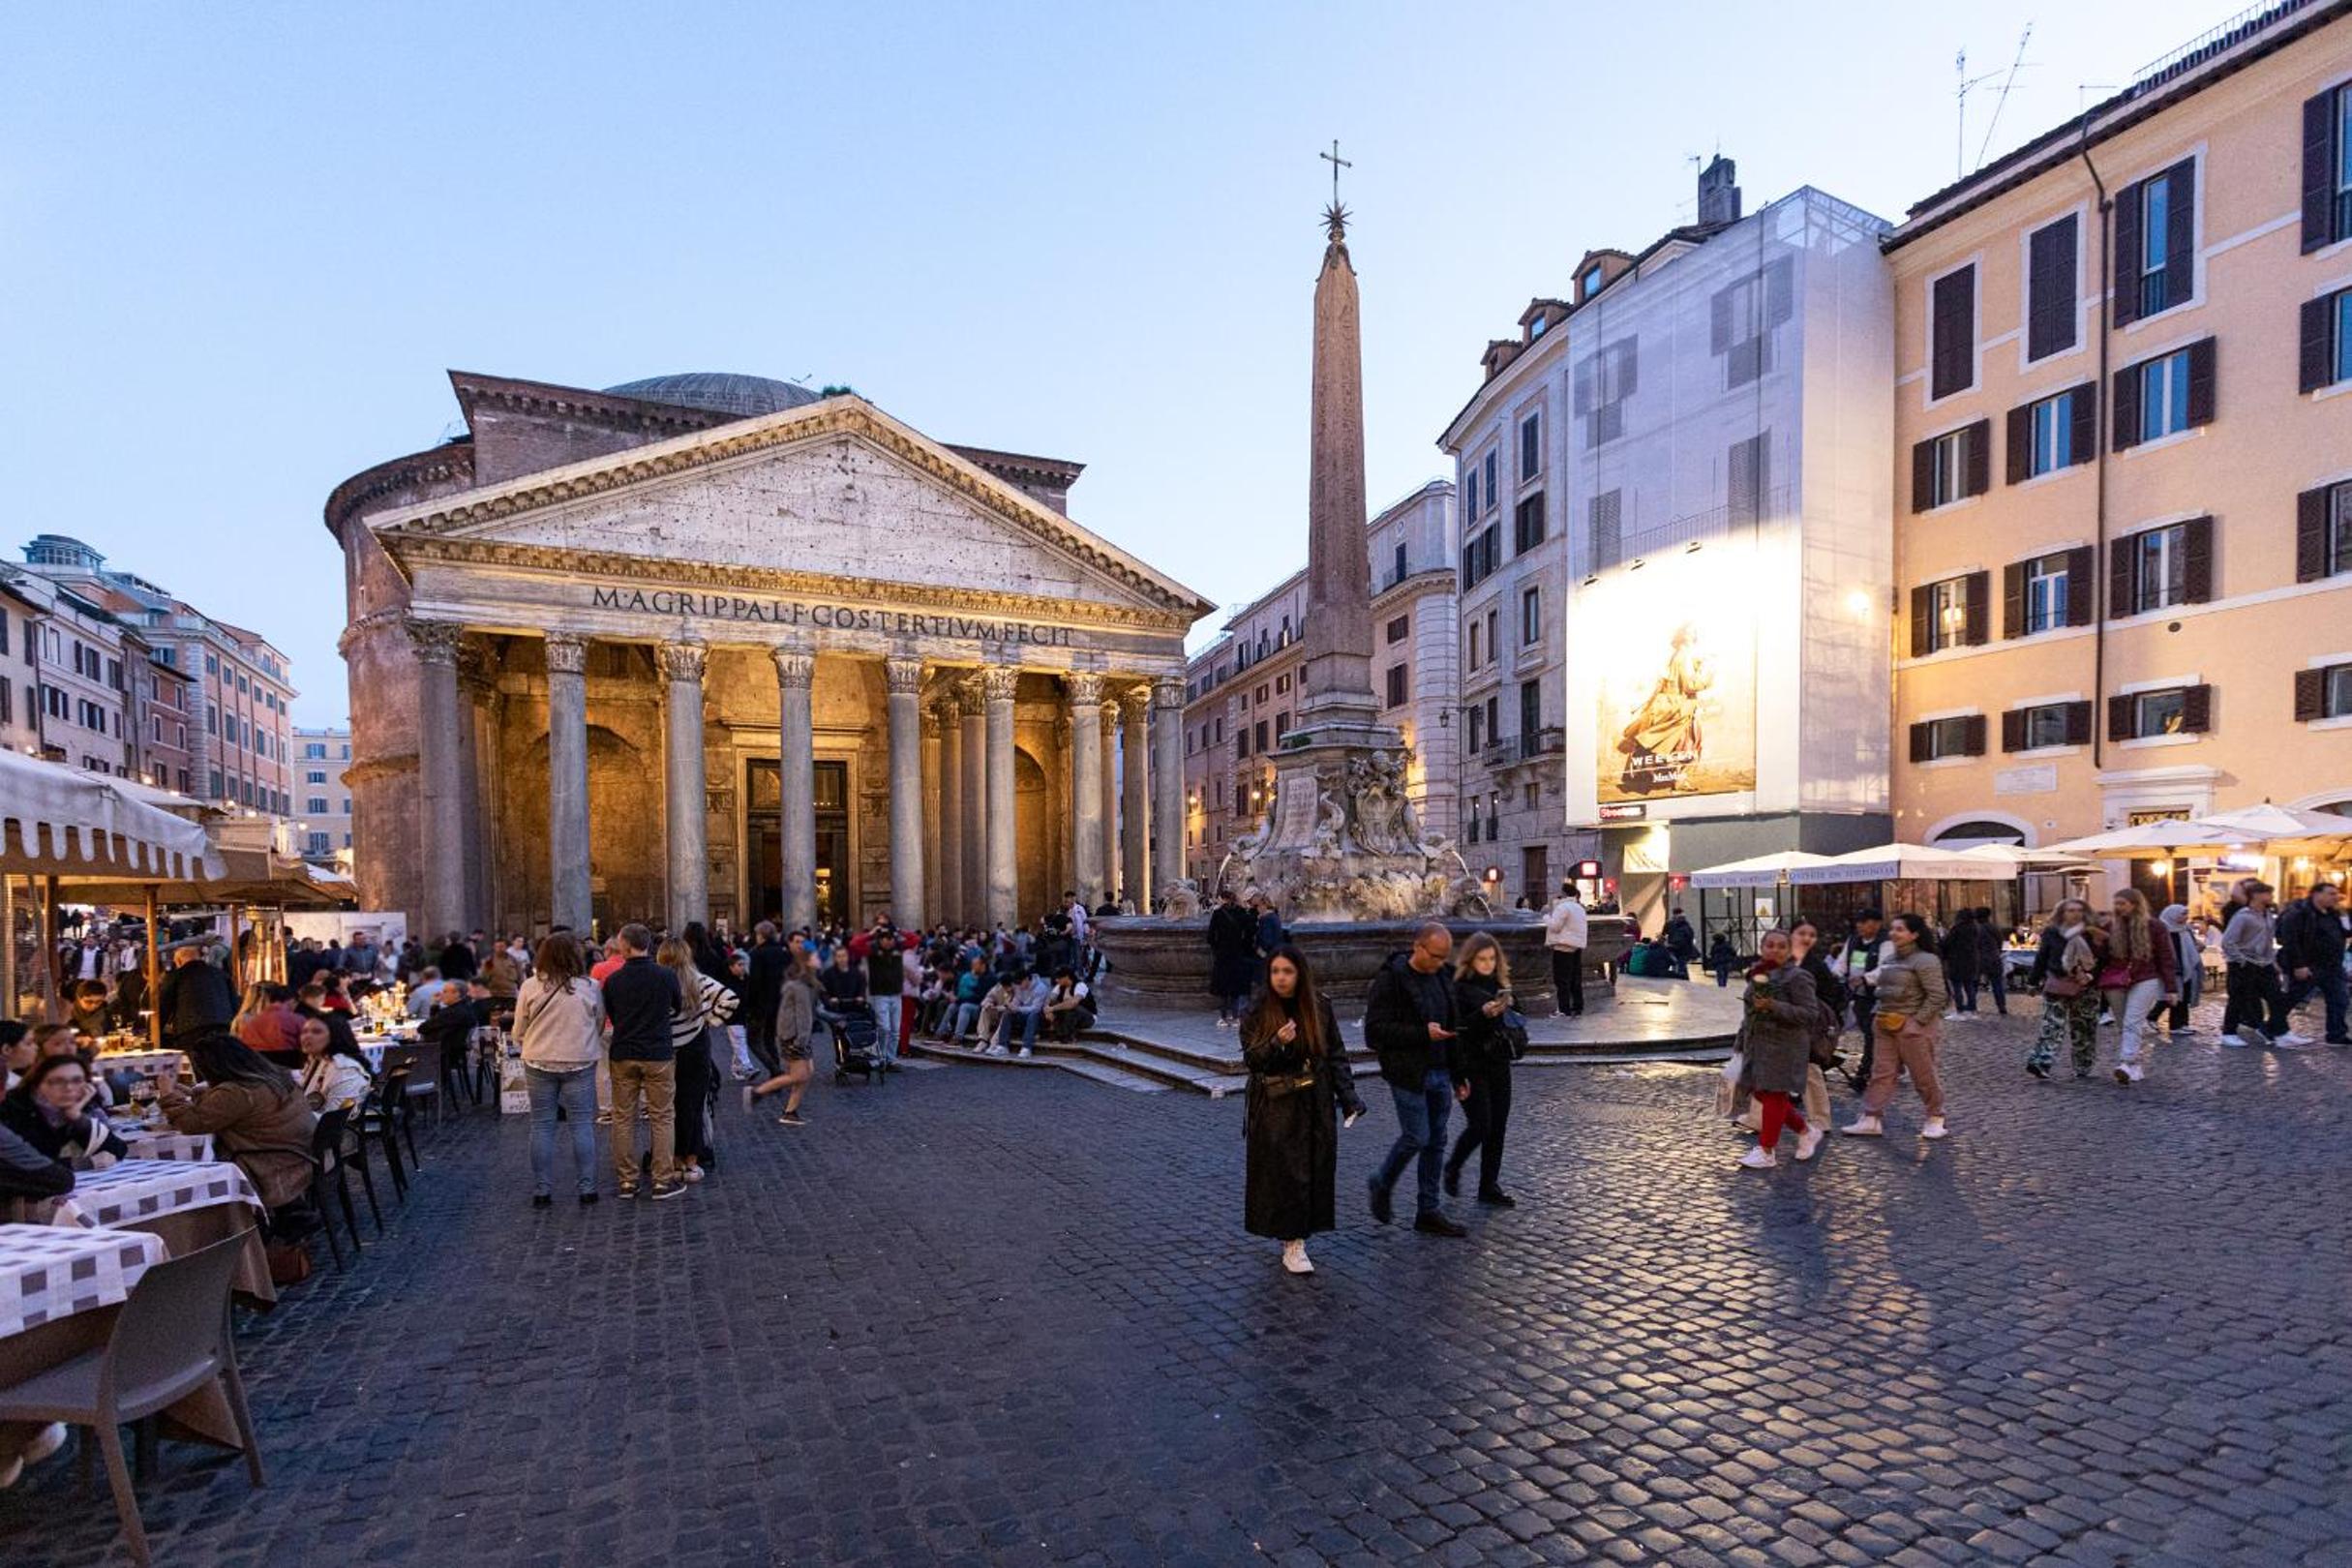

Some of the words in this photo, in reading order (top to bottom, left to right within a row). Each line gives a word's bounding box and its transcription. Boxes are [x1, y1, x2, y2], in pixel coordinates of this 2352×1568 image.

[629, 589, 766, 621] AGRIPPA
[812, 604, 870, 628] COS
[875, 611, 997, 641] TERTIVM
[1005, 621, 1076, 647] FECIT
